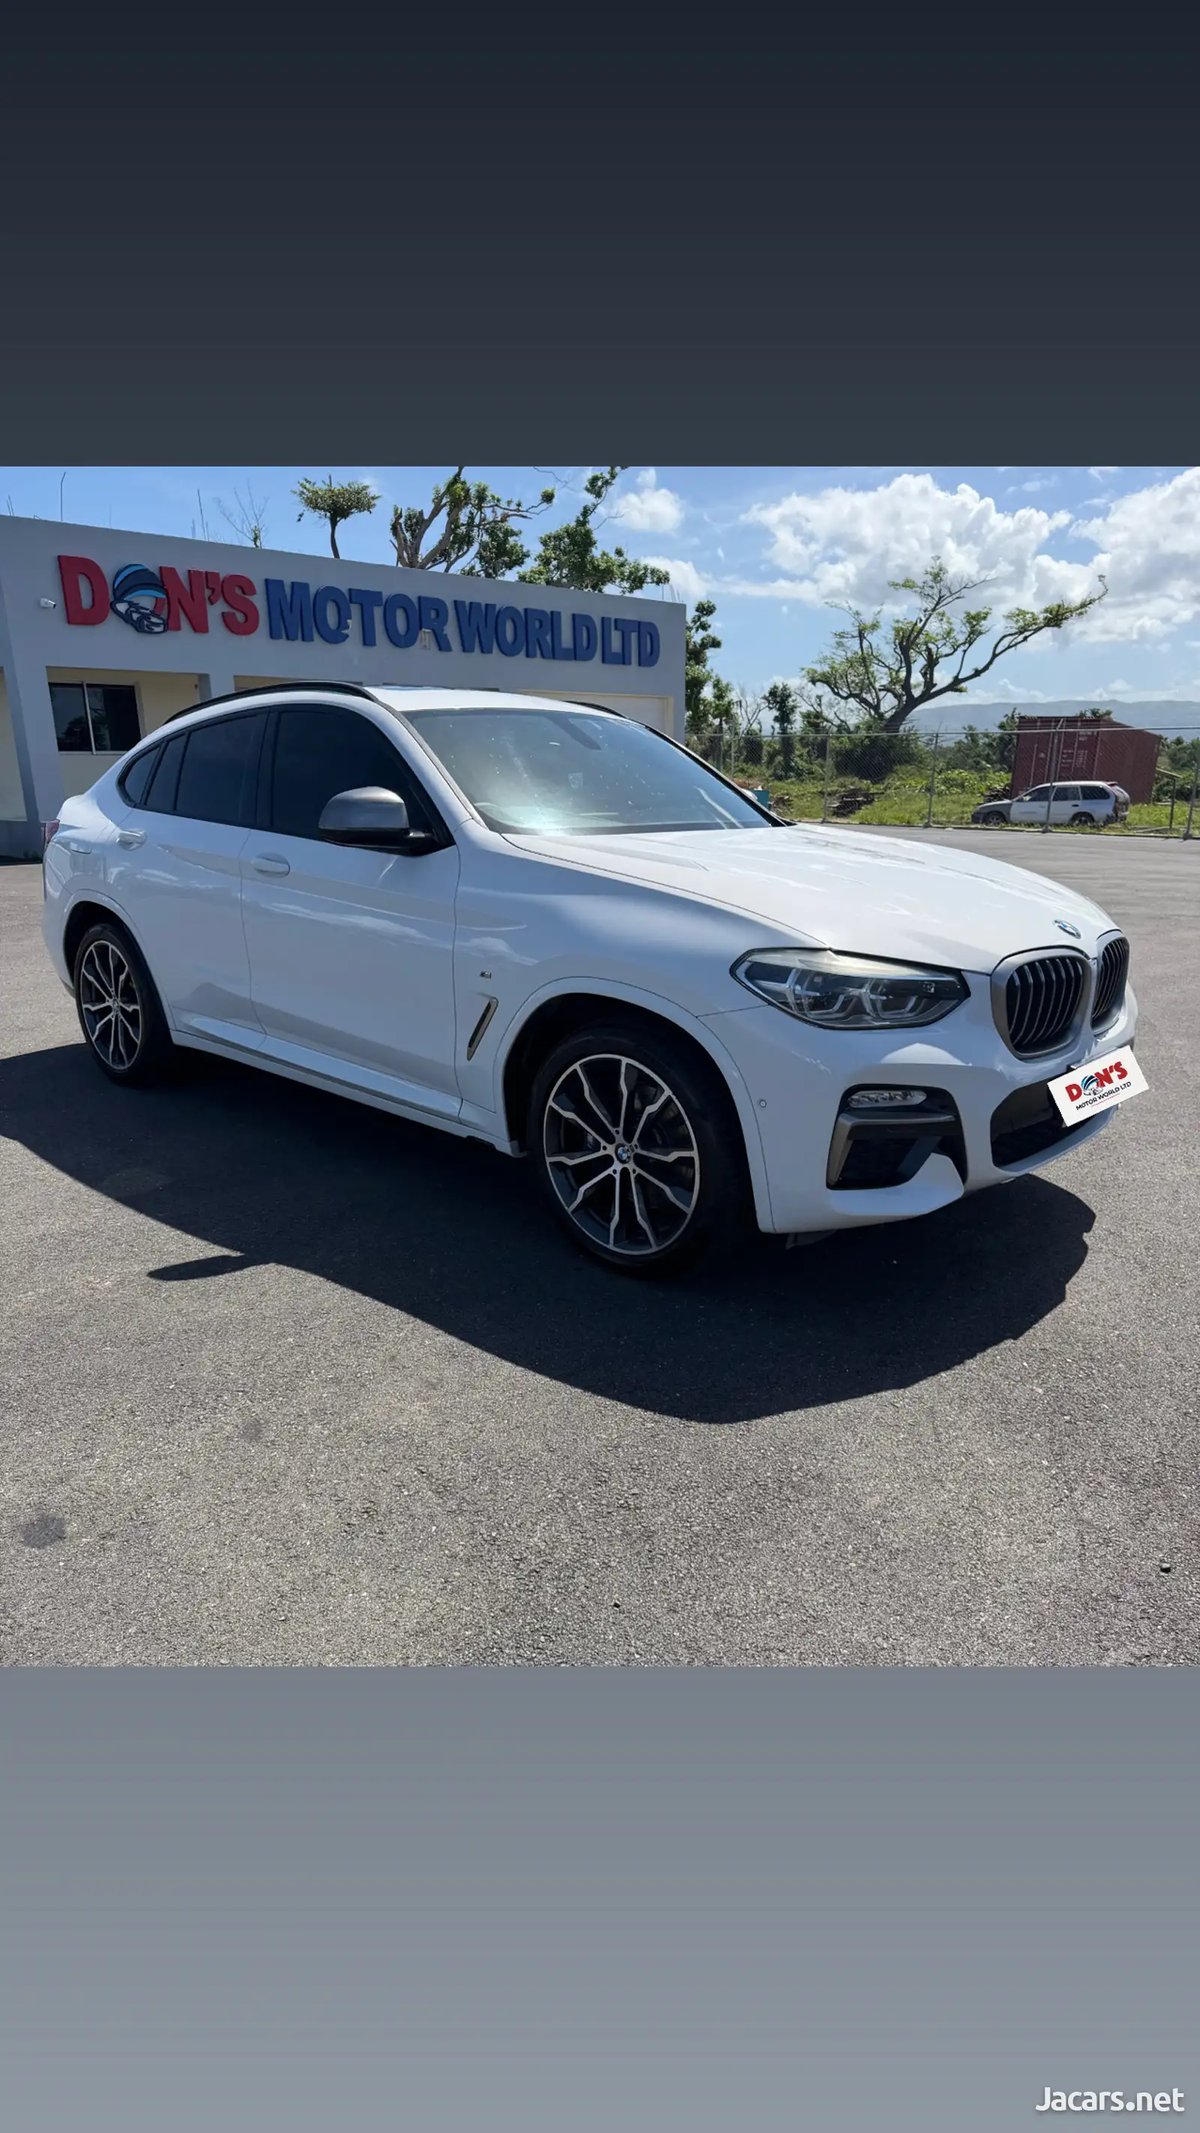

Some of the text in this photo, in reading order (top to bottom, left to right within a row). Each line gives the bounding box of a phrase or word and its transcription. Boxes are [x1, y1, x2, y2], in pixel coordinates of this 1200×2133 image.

[57, 555, 660, 667] DON'S MOTOR WORLD LTD
